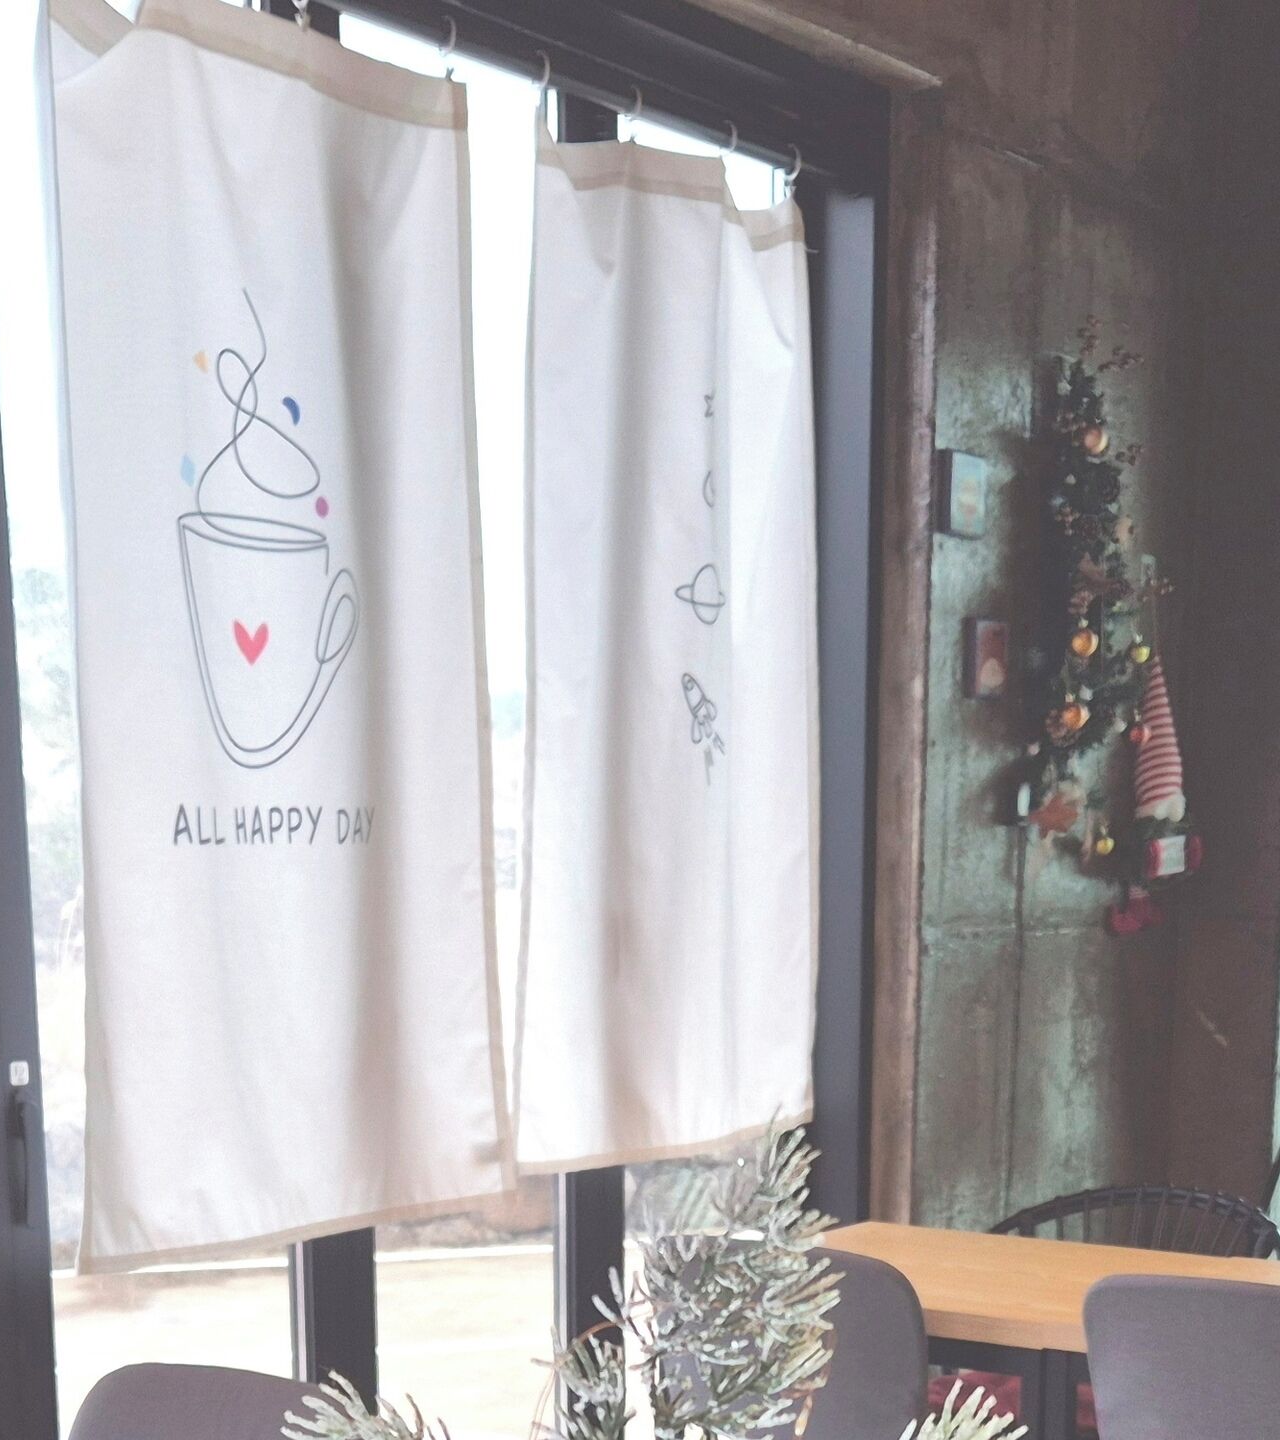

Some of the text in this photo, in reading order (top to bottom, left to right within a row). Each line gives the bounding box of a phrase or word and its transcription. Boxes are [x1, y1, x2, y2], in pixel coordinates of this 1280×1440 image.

[173, 803, 376, 845] ALL HAPPY DAY
